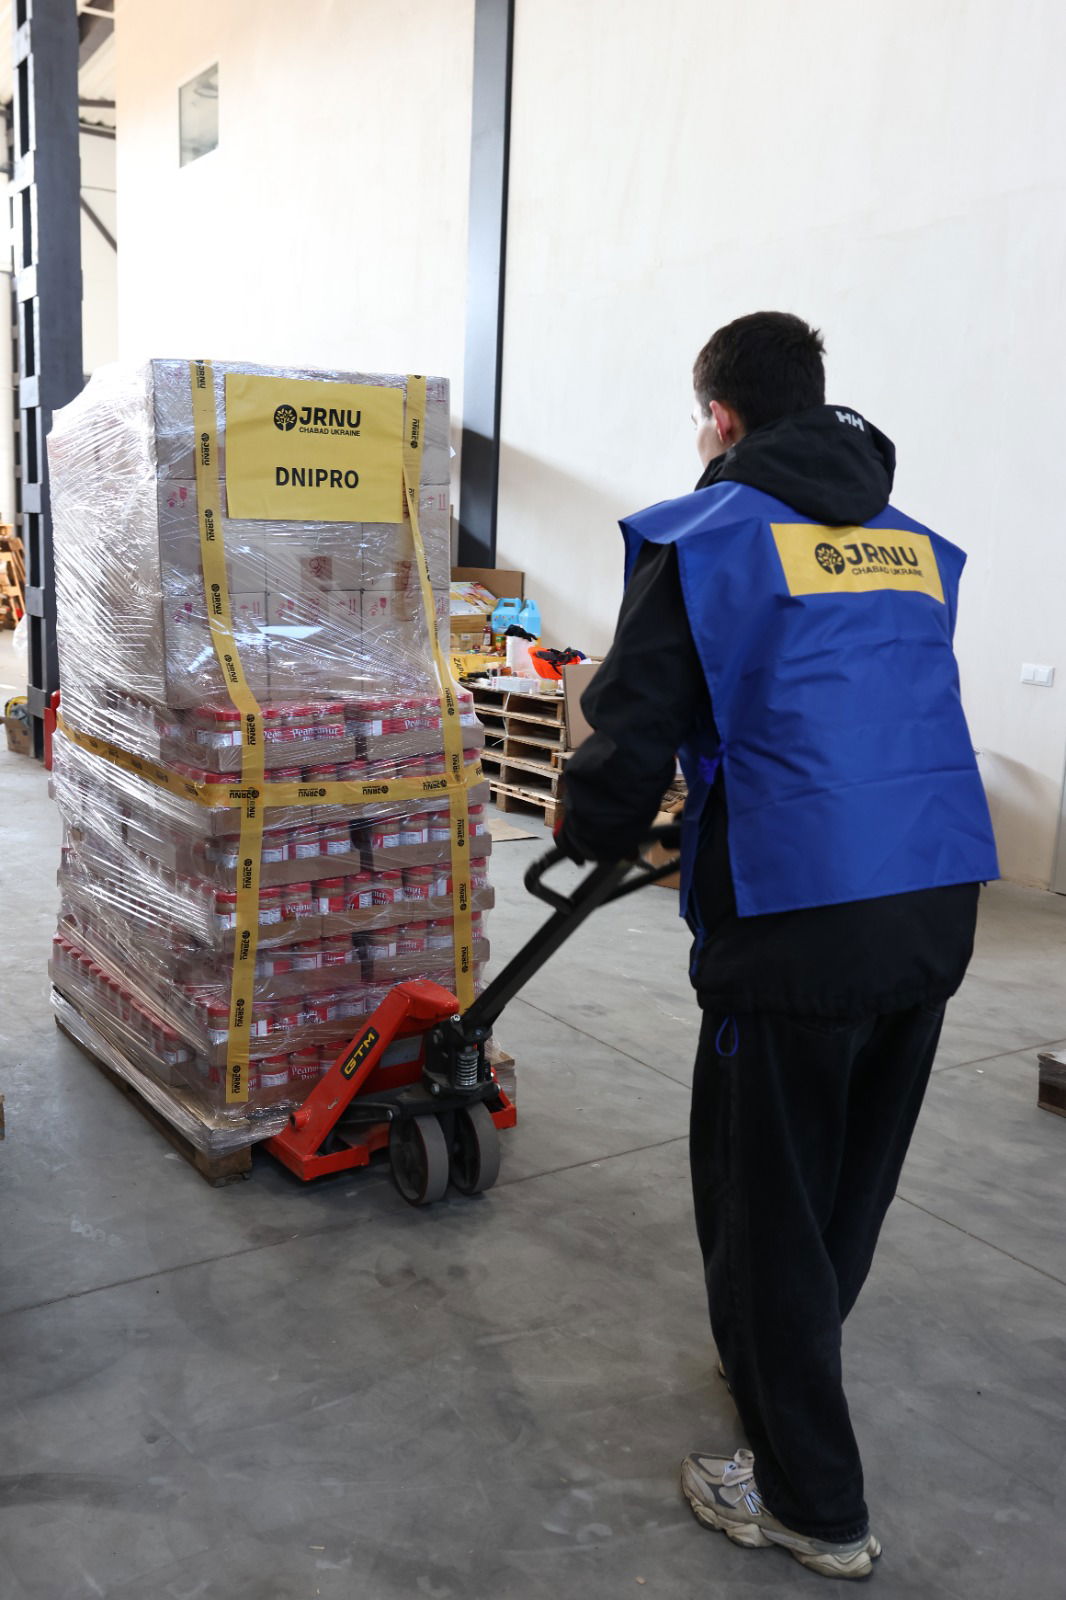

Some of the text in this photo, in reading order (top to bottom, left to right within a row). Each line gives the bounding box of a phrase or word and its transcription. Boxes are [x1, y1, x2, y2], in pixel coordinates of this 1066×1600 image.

[299, 406, 361, 428] JRNU
[835, 410, 865, 432] HH
[299, 426, 360, 437] CHABAD UKRAINE
[275, 466, 359, 489] DNIPRO
[843, 542, 919, 567] JRNU
[852, 564, 925, 578] CHABAD UKRAINE
[214, 593, 222, 615] JRNU
[228, 663, 239, 683] JRNU
[229, 791, 252, 799] JRNU
[423, 783, 441, 791] JRNU
[344, 1032, 375, 1075] GTM
